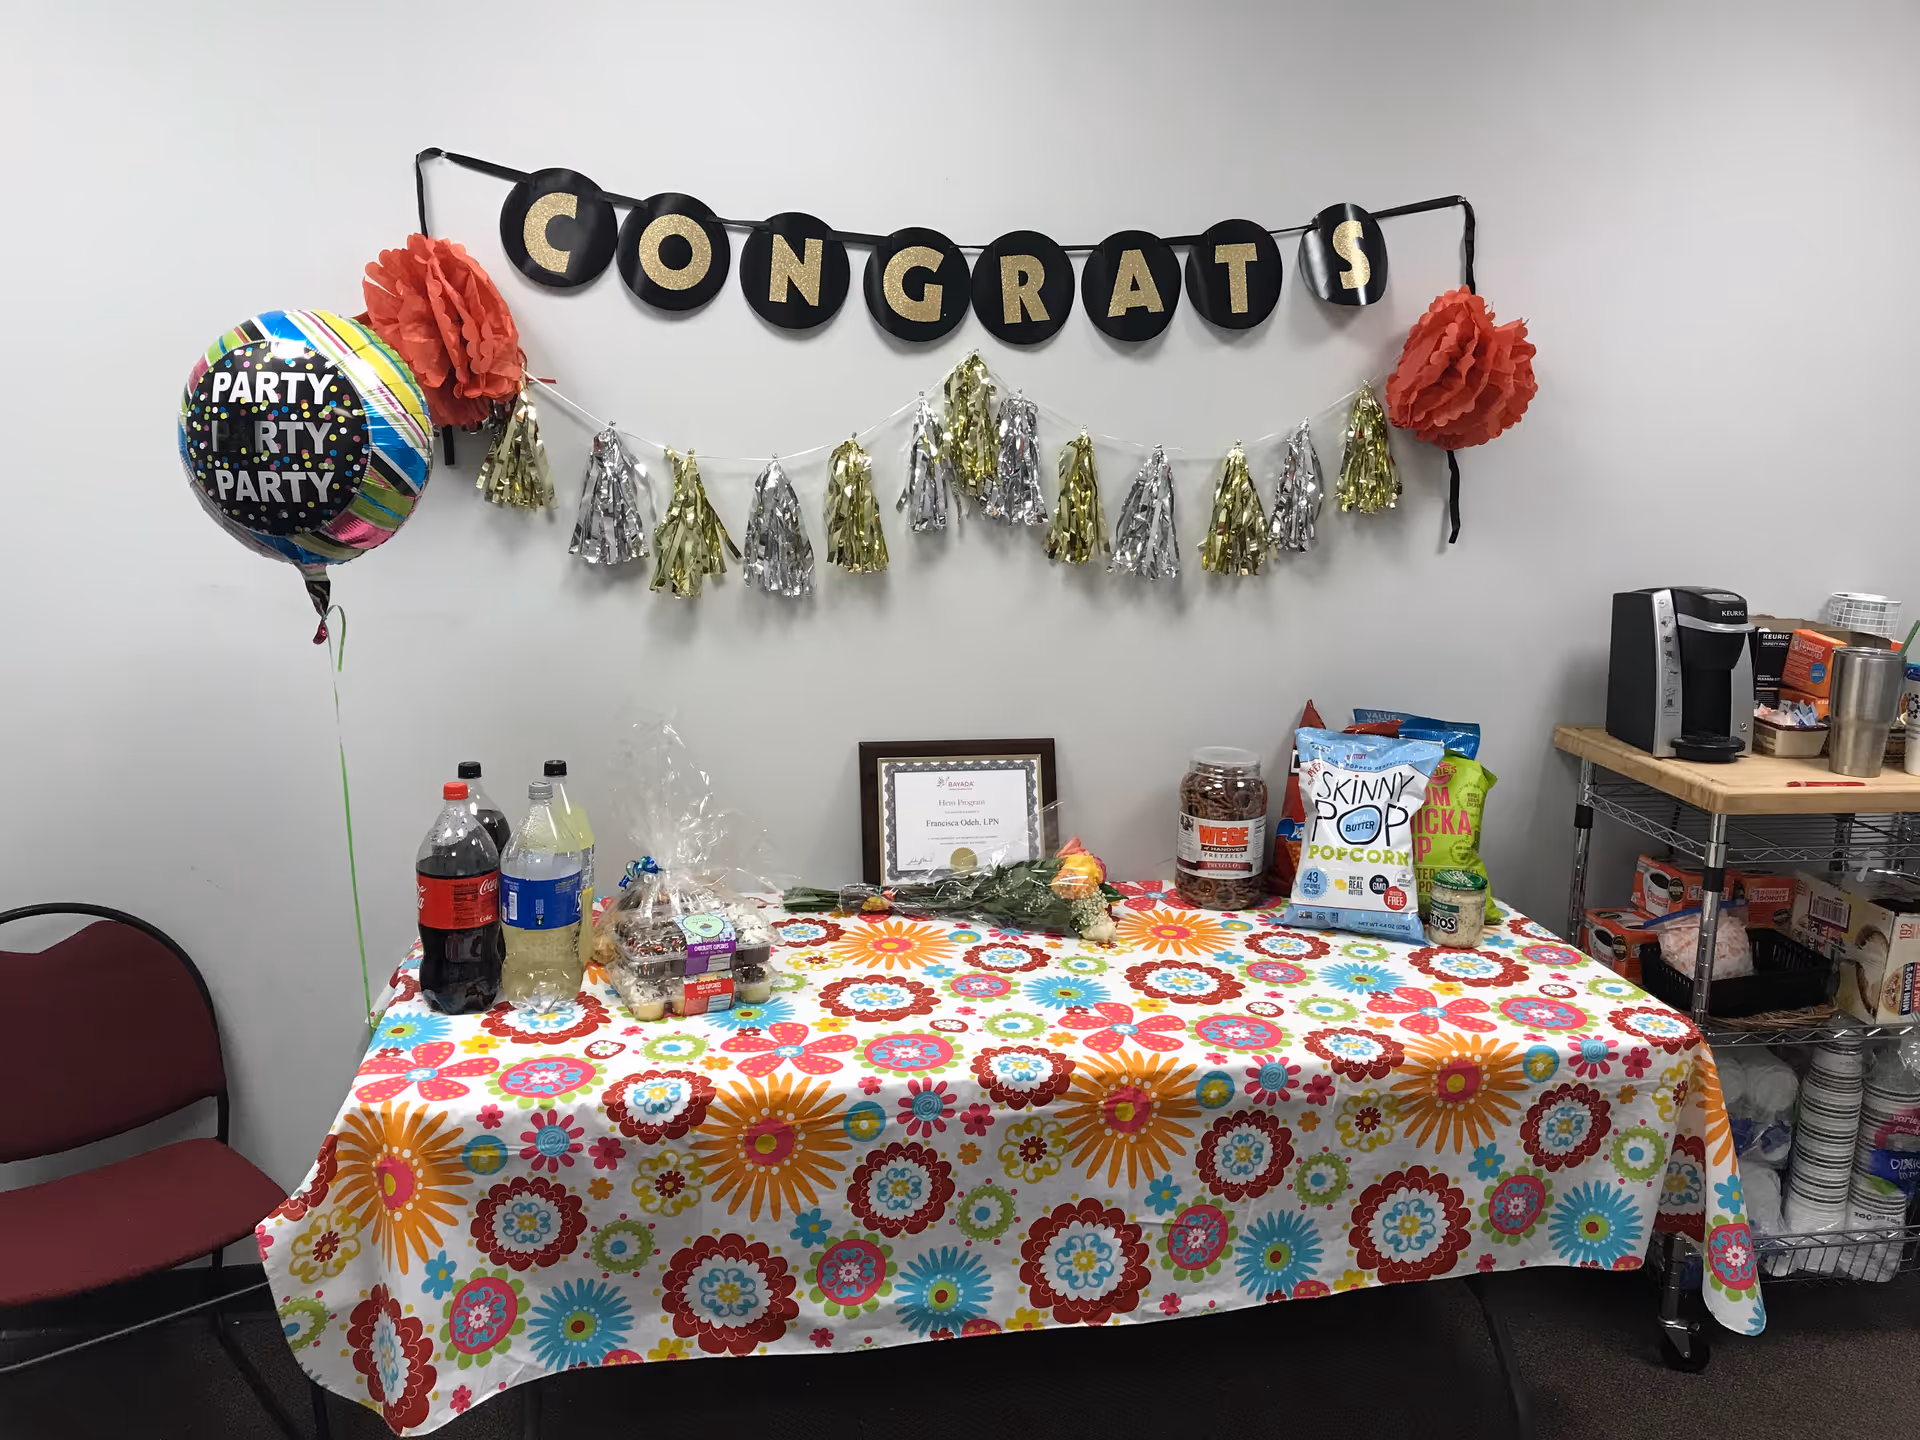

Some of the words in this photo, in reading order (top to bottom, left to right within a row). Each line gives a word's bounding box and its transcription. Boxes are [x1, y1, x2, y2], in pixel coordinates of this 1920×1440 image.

[523, 192, 1372, 325] CONGRATS
[211, 371, 334, 405] PARTY
[215, 470, 334, 503] PARTY
[1365, 711, 1397, 720] VALUE
[1317, 771, 1415, 805] SKINNY
[926, 819, 959, 827] Francisca
[960, 818, 981, 827] Odeh,
[983, 817, 1000, 825] LPN
[1311, 799, 1409, 847] POP
[1345, 820, 1375, 832] BUTTER
[1351, 814, 1370, 824] REAL
[1199, 825, 1249, 845] WEGE
[1308, 845, 1410, 866] POPCORN
[1306, 871, 1319, 883] 43
[1348, 880, 1364, 889] REAL
[1373, 882, 1386, 891] GMO
[1387, 896, 1404, 906] FREE
[479, 914, 493, 923] Coke
[1899, 923, 1913, 939] 192
[1904, 966, 1913, 991] MOO'S
[1901, 992, 1911, 1011] MINI
